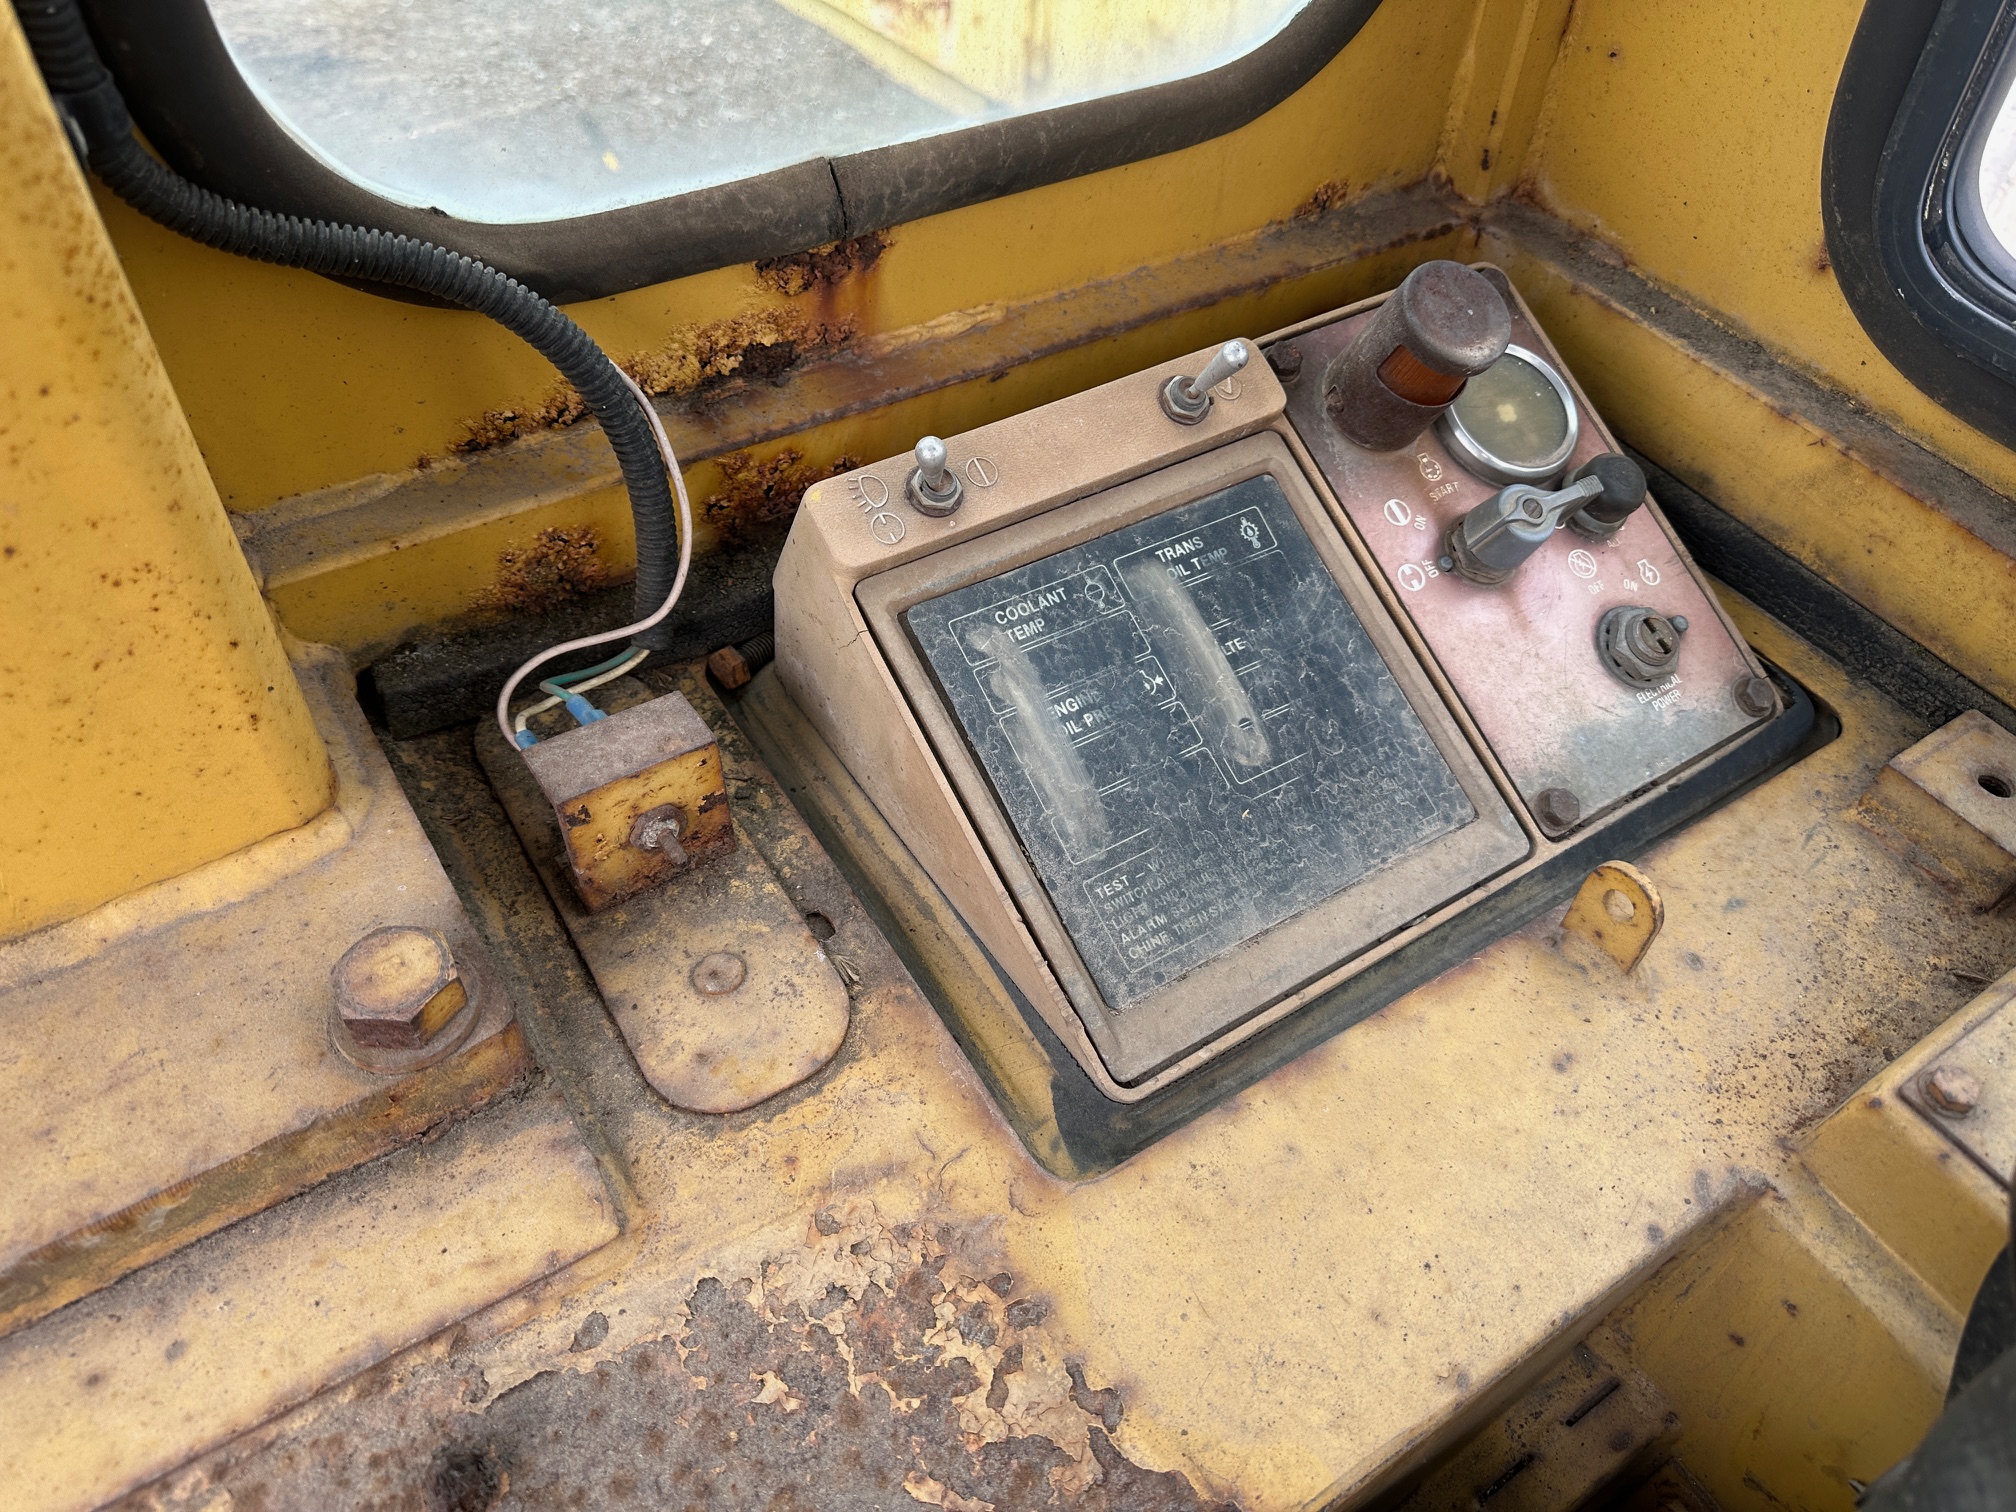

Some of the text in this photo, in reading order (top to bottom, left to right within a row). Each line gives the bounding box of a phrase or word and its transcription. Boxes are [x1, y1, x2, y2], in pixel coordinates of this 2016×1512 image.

[1429, 481, 1459, 502] START
[1414, 515, 1427, 531] ON
[1154, 534, 1204, 564] TRANS
[1165, 546, 1229, 581] OIL TEMP
[1422, 560, 1439, 578] OFF
[1587, 579, 1638, 596] OFF ON
[994, 587, 1068, 625] COOLANT
[1006, 618, 1046, 644] TEMP
[1651, 689, 1682, 712] POWER
[1094, 874, 1131, 900] TEST
[1119, 912, 1168, 944] ALARM
